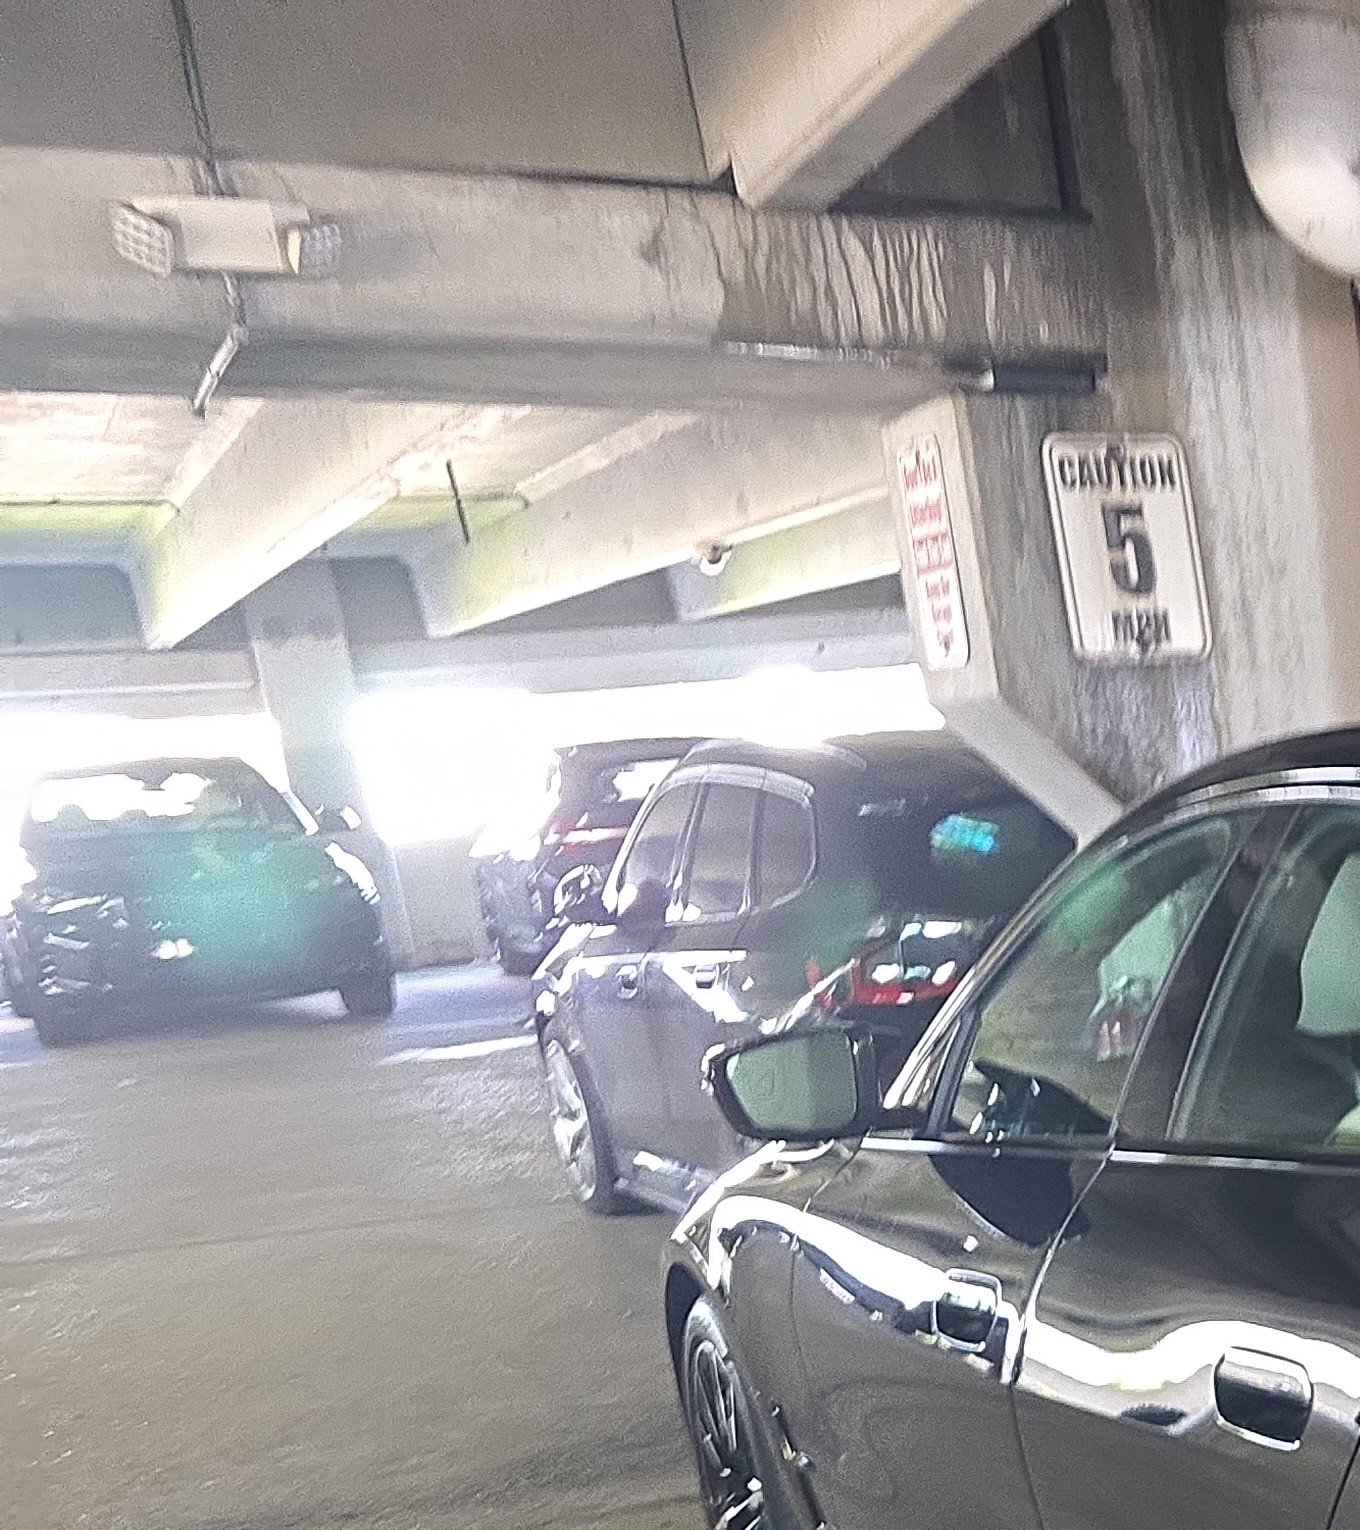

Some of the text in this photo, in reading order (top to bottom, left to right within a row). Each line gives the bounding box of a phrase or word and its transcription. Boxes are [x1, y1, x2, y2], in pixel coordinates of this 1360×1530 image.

[1057, 454, 1177, 491] CAUTION
[1101, 502, 1158, 594] 5
[1111, 608, 1172, 646] MPH
